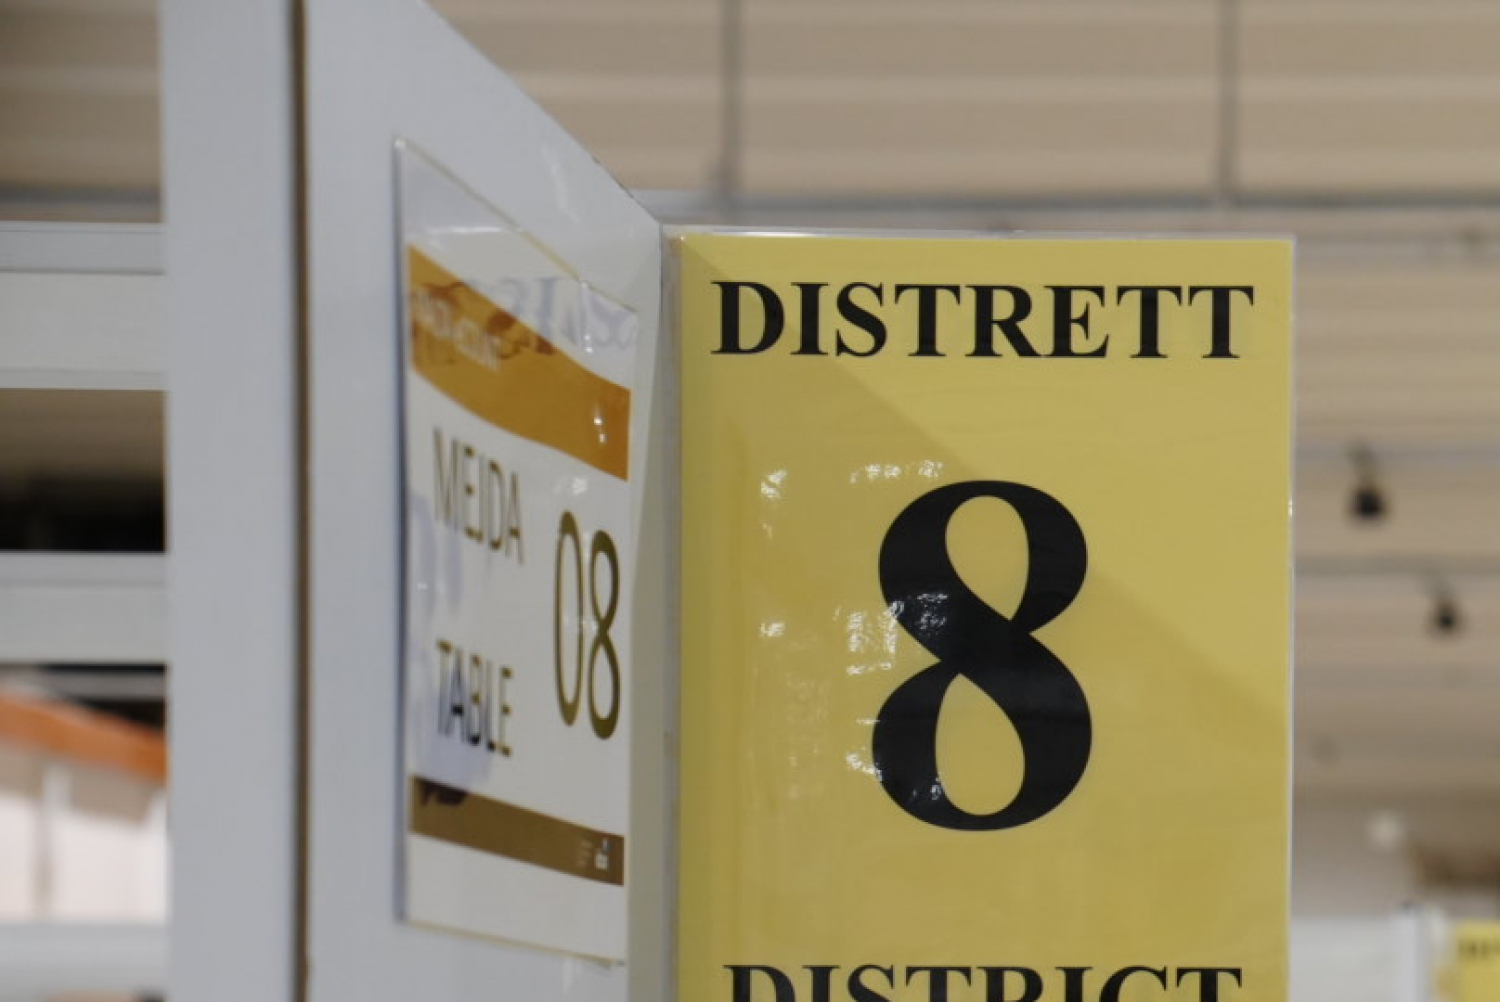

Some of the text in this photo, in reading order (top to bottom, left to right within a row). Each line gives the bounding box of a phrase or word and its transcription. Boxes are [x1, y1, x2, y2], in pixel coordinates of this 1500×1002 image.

[711, 281, 1253, 358] DISTRETT
[434, 427, 524, 565] MEJDA
[555, 510, 620, 740] 08
[872, 480, 1092, 831] 8
[437, 639, 513, 757] TABLE
